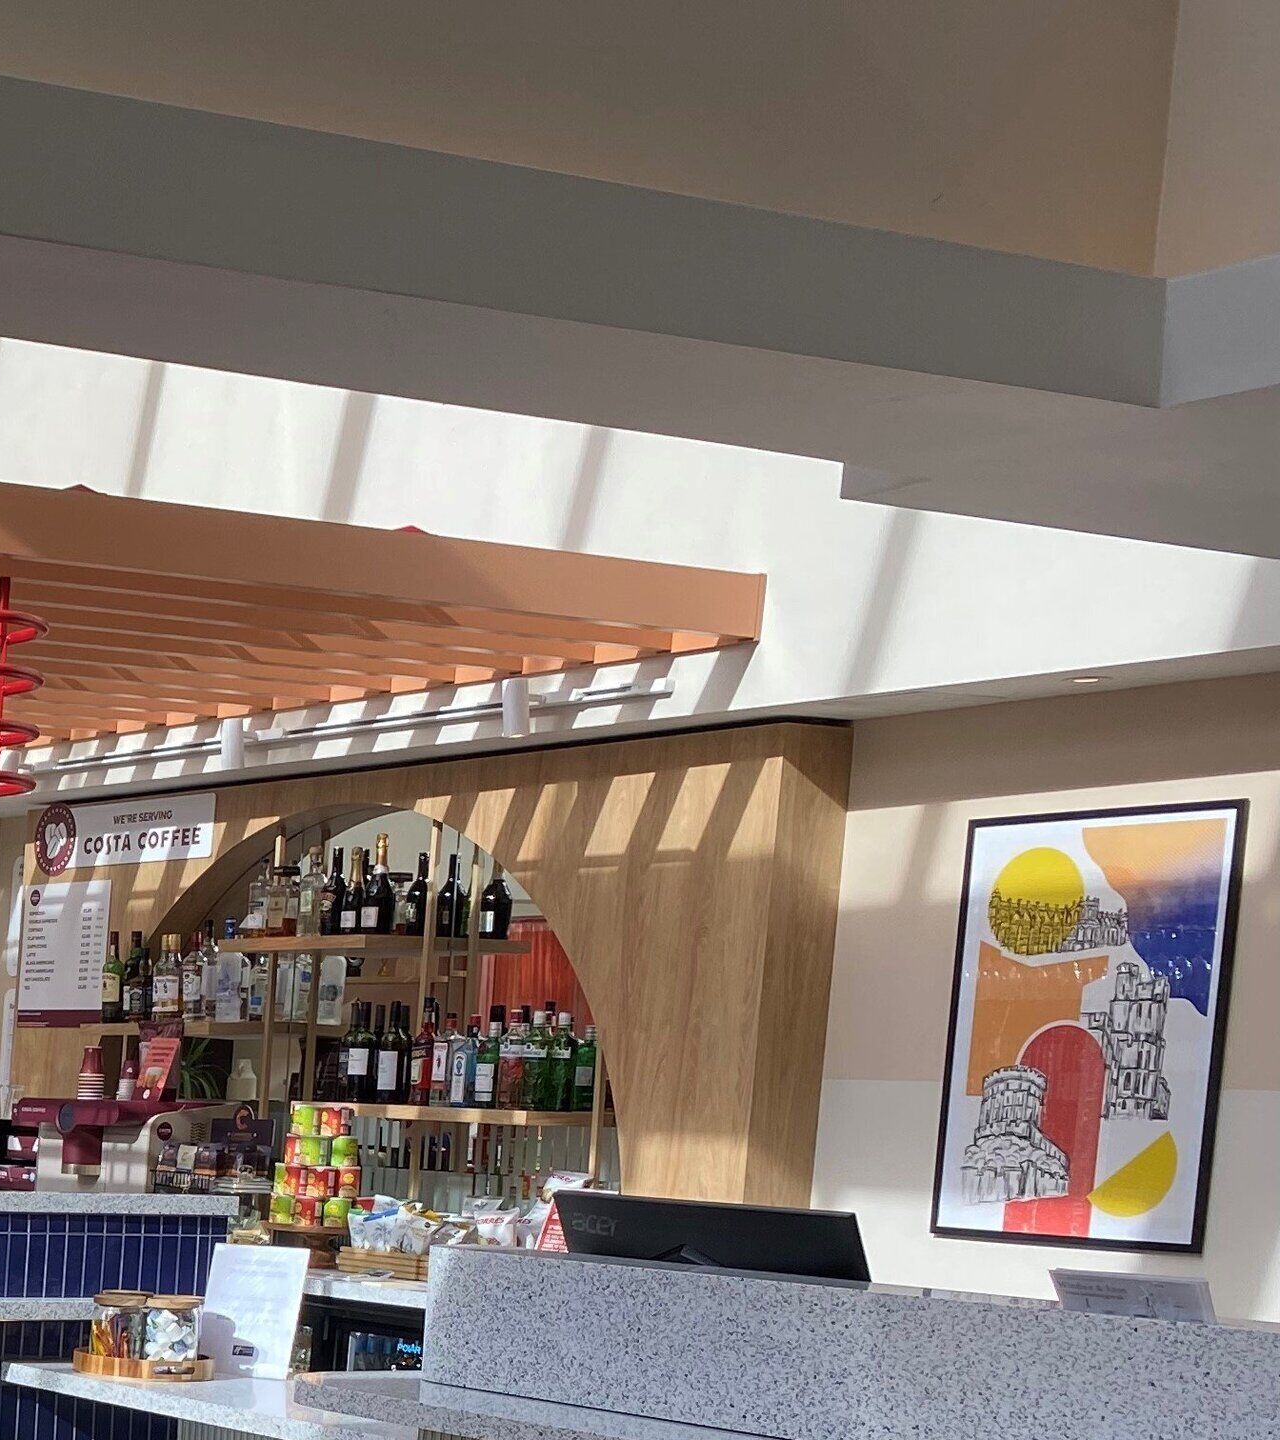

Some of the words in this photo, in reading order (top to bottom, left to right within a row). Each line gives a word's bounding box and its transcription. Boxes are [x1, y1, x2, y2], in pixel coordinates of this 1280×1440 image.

[113, 813, 137, 825] WE'RE
[138, 810, 173, 823] SERVING
[83, 834, 132, 855] COSTA
[137, 827, 202, 850] COFFEE
[571, 1214, 618, 1236] acer
